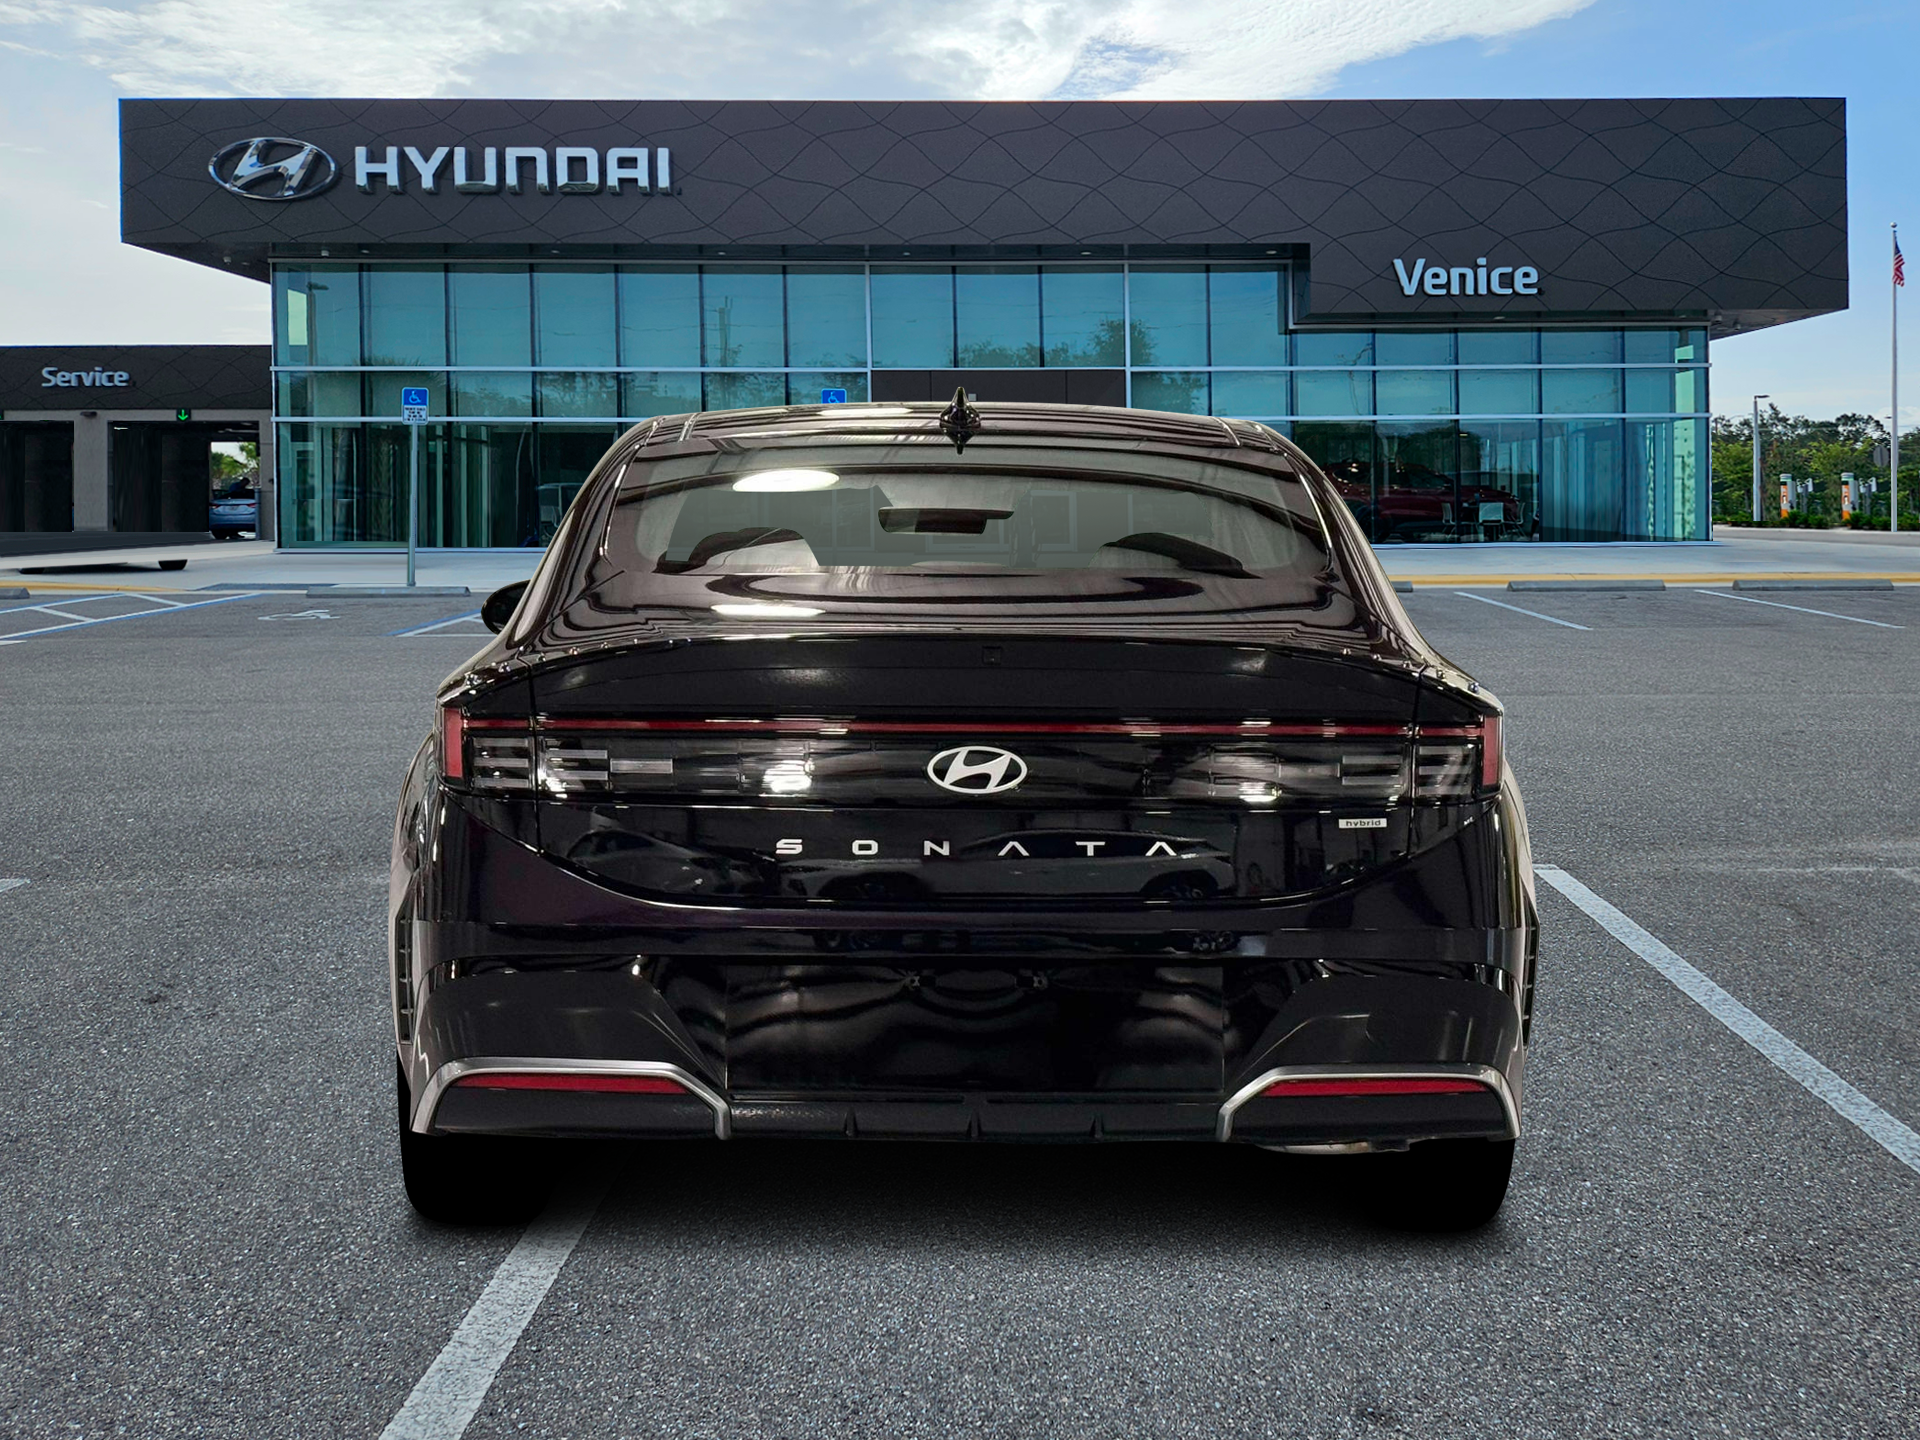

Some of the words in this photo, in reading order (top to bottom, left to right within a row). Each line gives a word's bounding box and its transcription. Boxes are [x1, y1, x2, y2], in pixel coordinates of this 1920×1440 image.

[355, 146, 671, 194] HYUNDAI
[1393, 257, 1539, 295] Venice
[41, 366, 129, 387] Service
[775, 838, 1177, 858] SONATA
